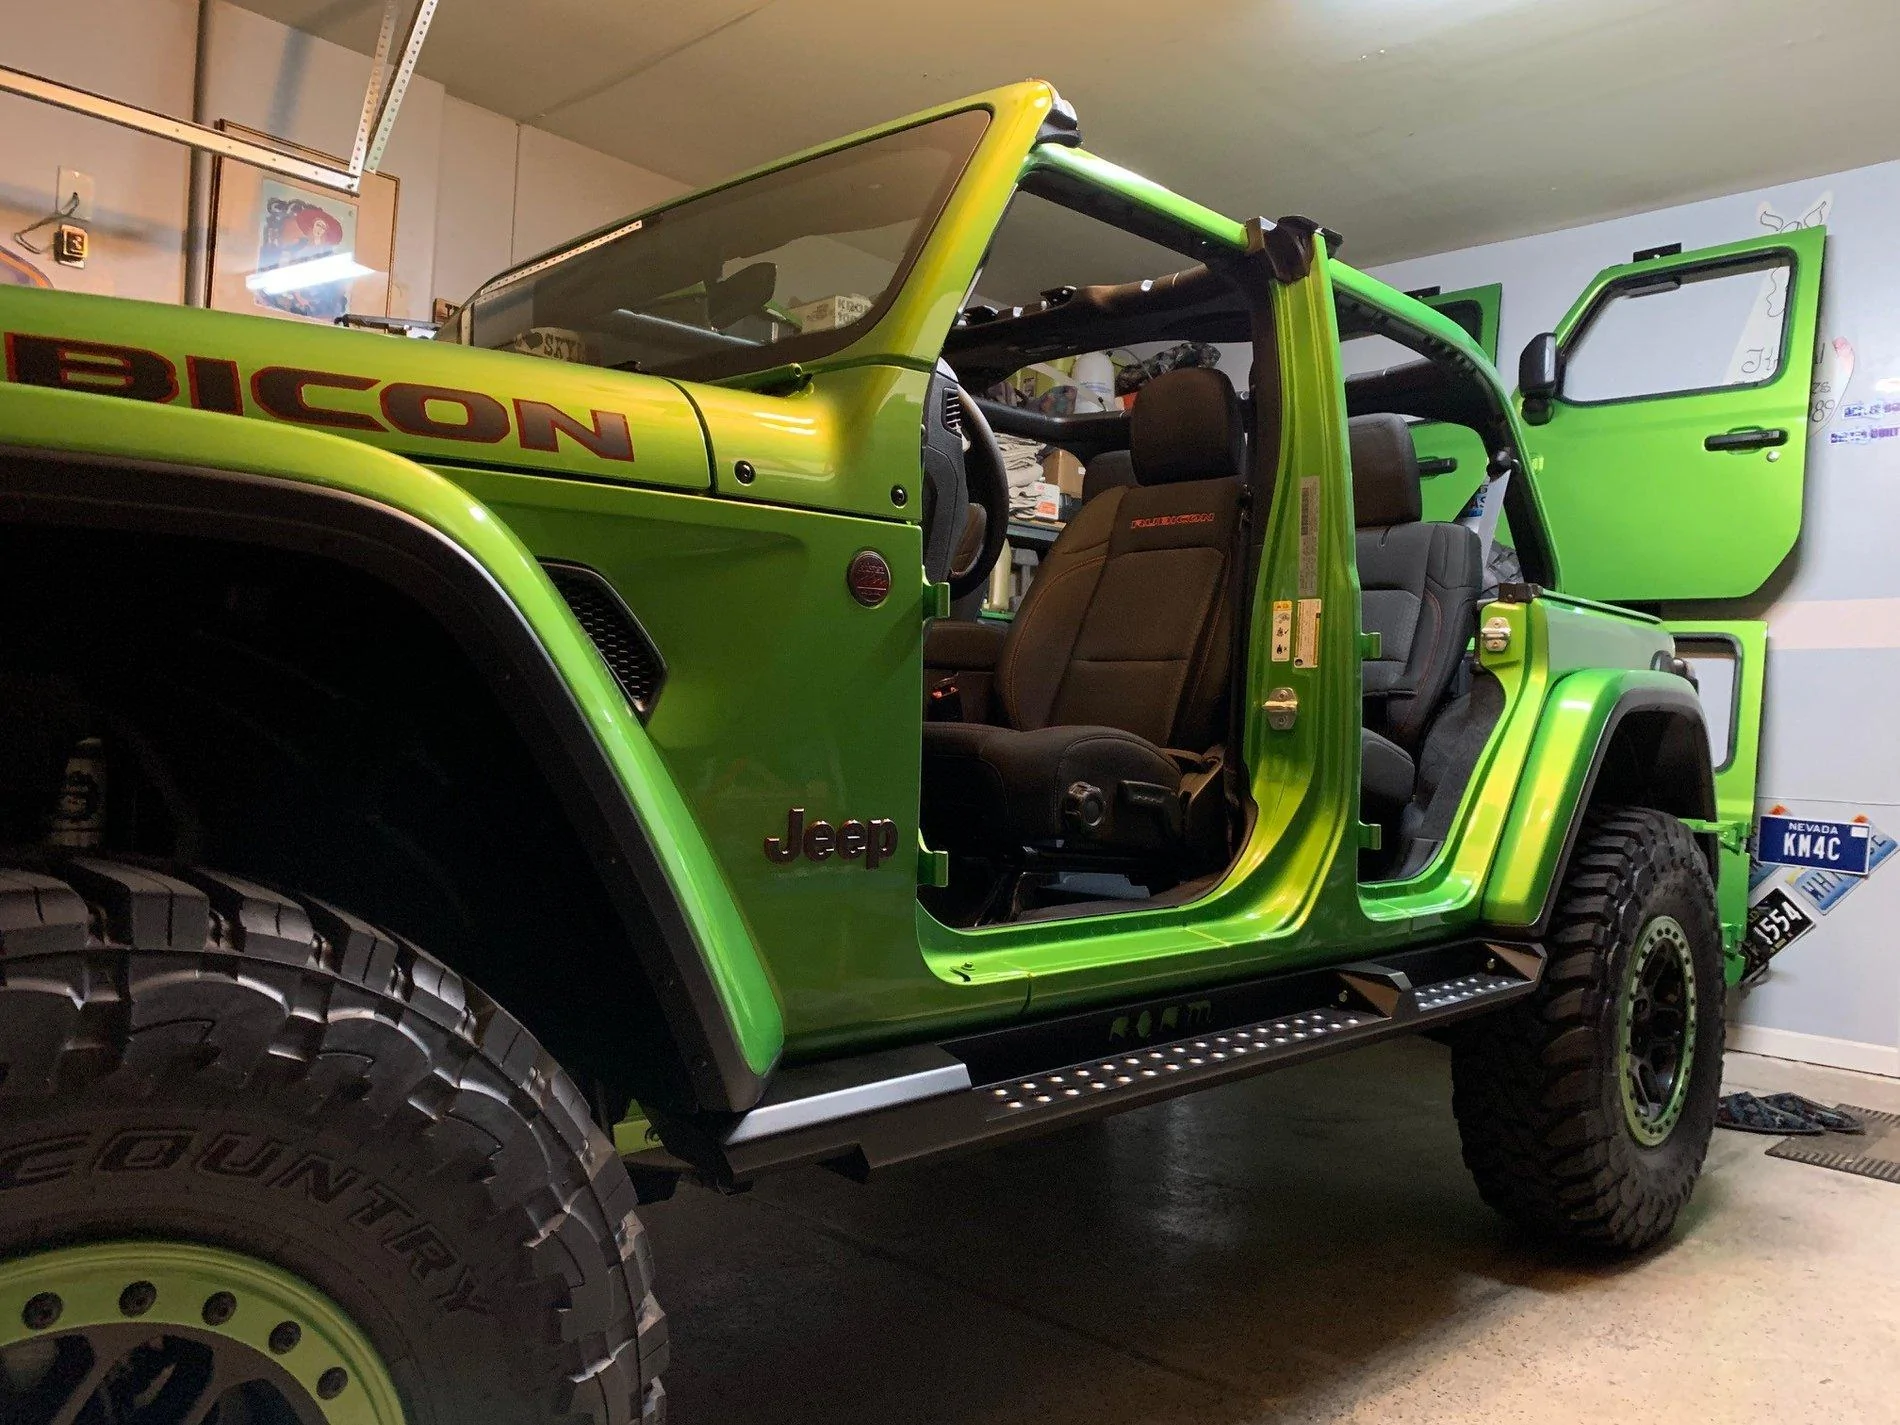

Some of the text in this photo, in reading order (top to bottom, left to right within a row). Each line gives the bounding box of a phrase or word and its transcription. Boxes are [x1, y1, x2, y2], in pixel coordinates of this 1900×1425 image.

[4, 331, 635, 463] BICON
[1131, 513, 1215, 528] RUBICON
[764, 807, 899, 872] Jeep
[1783, 831, 1842, 862] KM4C
[1788, 822, 1839, 835] NEVADA
[0, 1127, 490, 1315] COUNTRY
